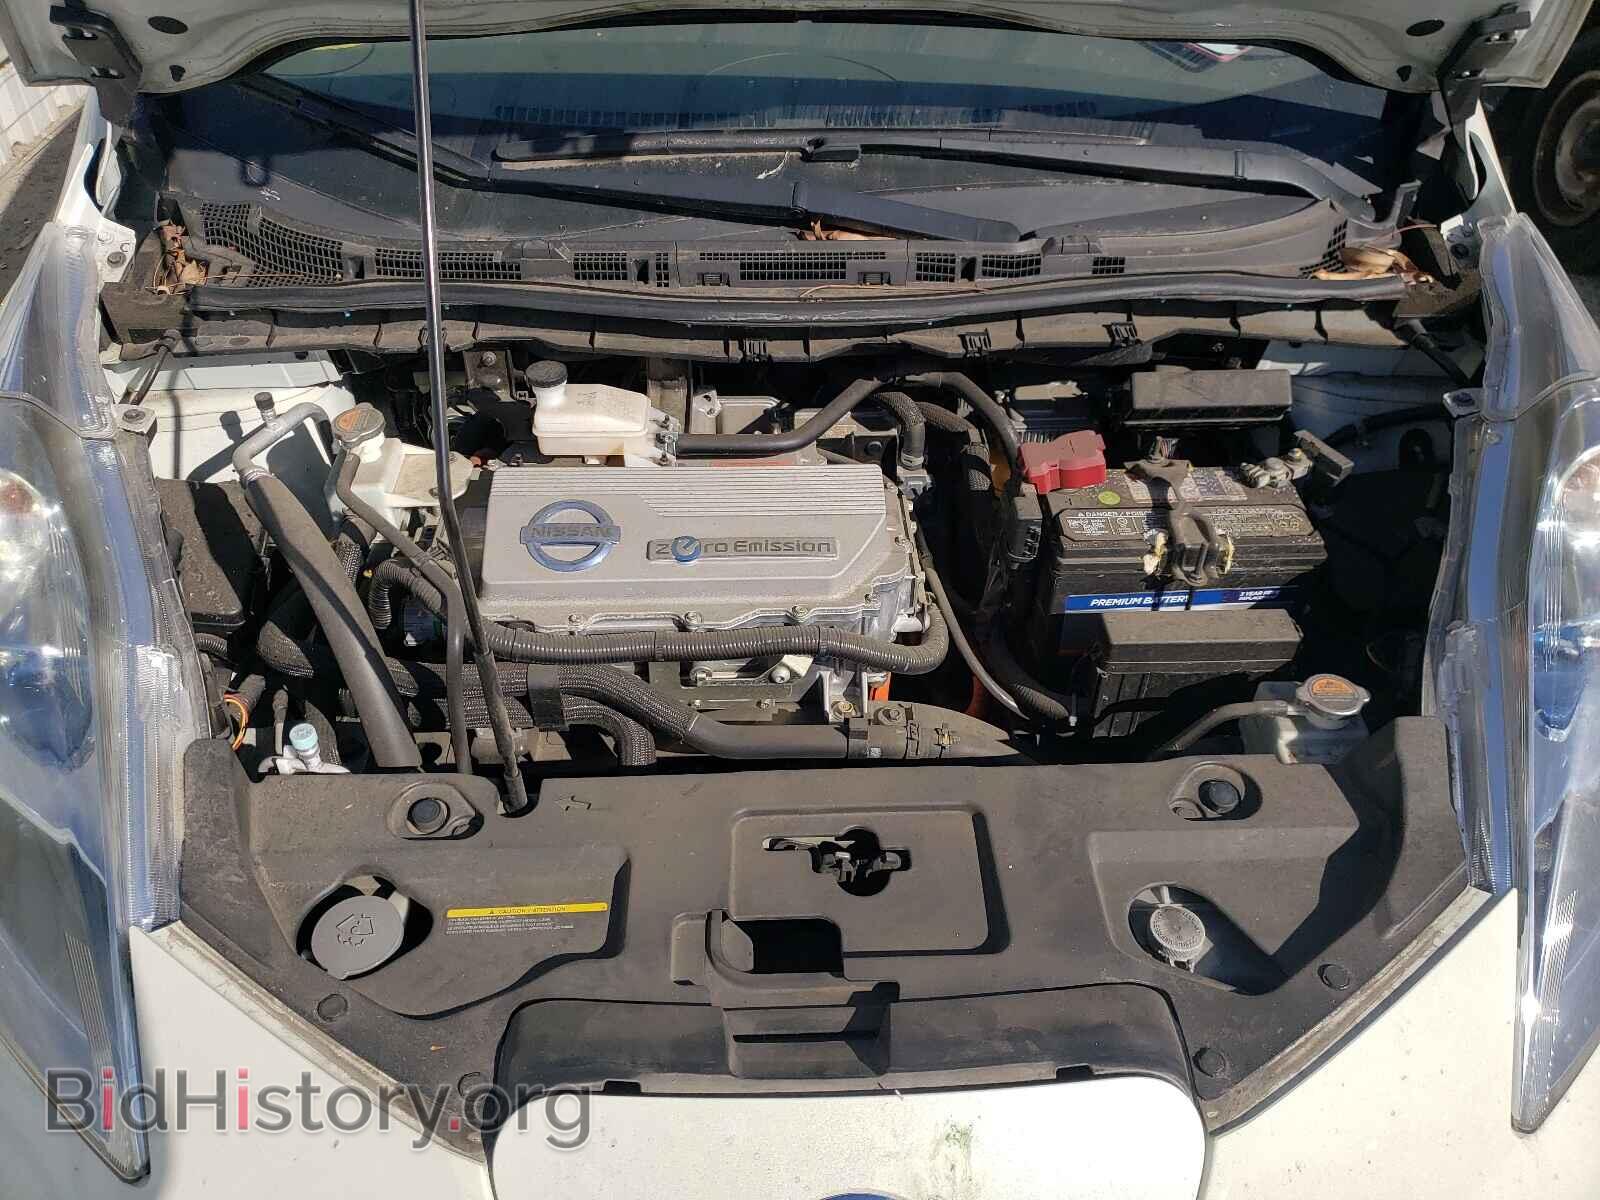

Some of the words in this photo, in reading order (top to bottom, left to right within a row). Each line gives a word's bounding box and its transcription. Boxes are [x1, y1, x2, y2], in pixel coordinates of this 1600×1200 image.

[531, 526, 609, 538] NISSAN
[733, 540, 831, 554] Emission
[1090, 597, 1141, 607] PREMIUM
[1142, 595, 1189, 604] BTTERY
